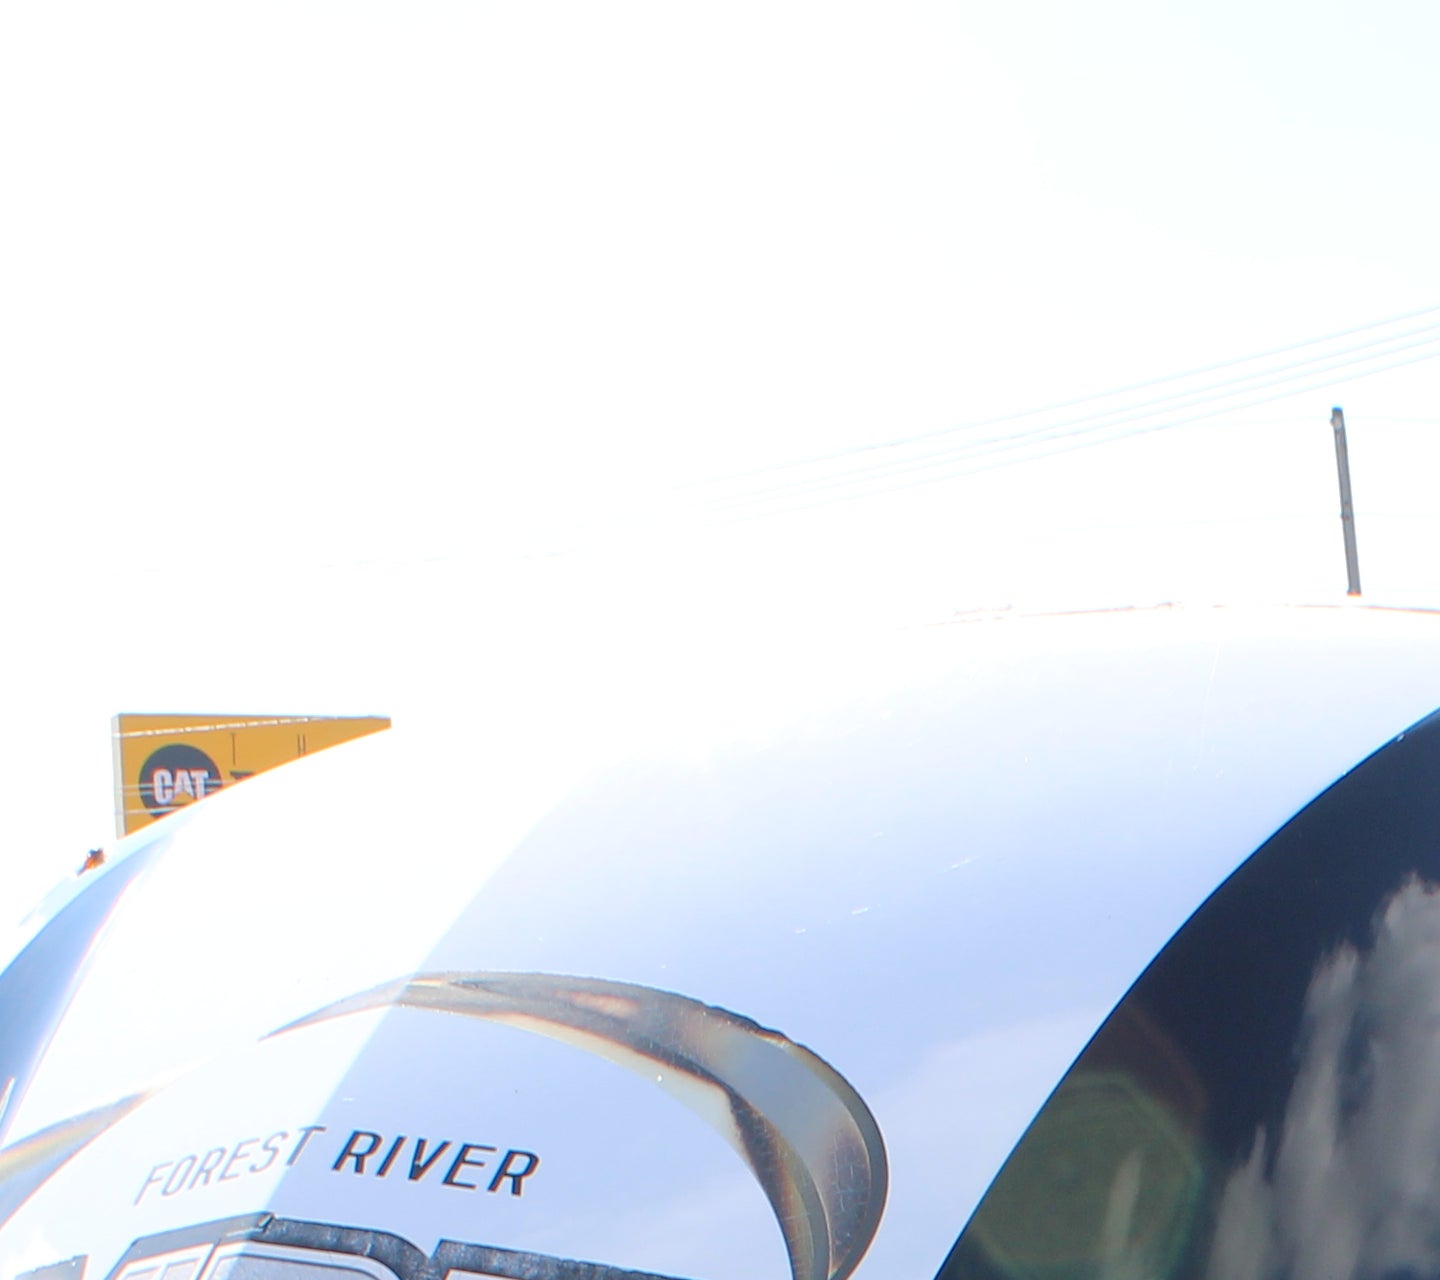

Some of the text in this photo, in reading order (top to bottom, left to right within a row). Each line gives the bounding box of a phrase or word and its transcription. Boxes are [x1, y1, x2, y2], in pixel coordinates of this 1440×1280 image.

[152, 767, 210, 806] CAT
[133, 1124, 540, 1207] FOREST RIVER
